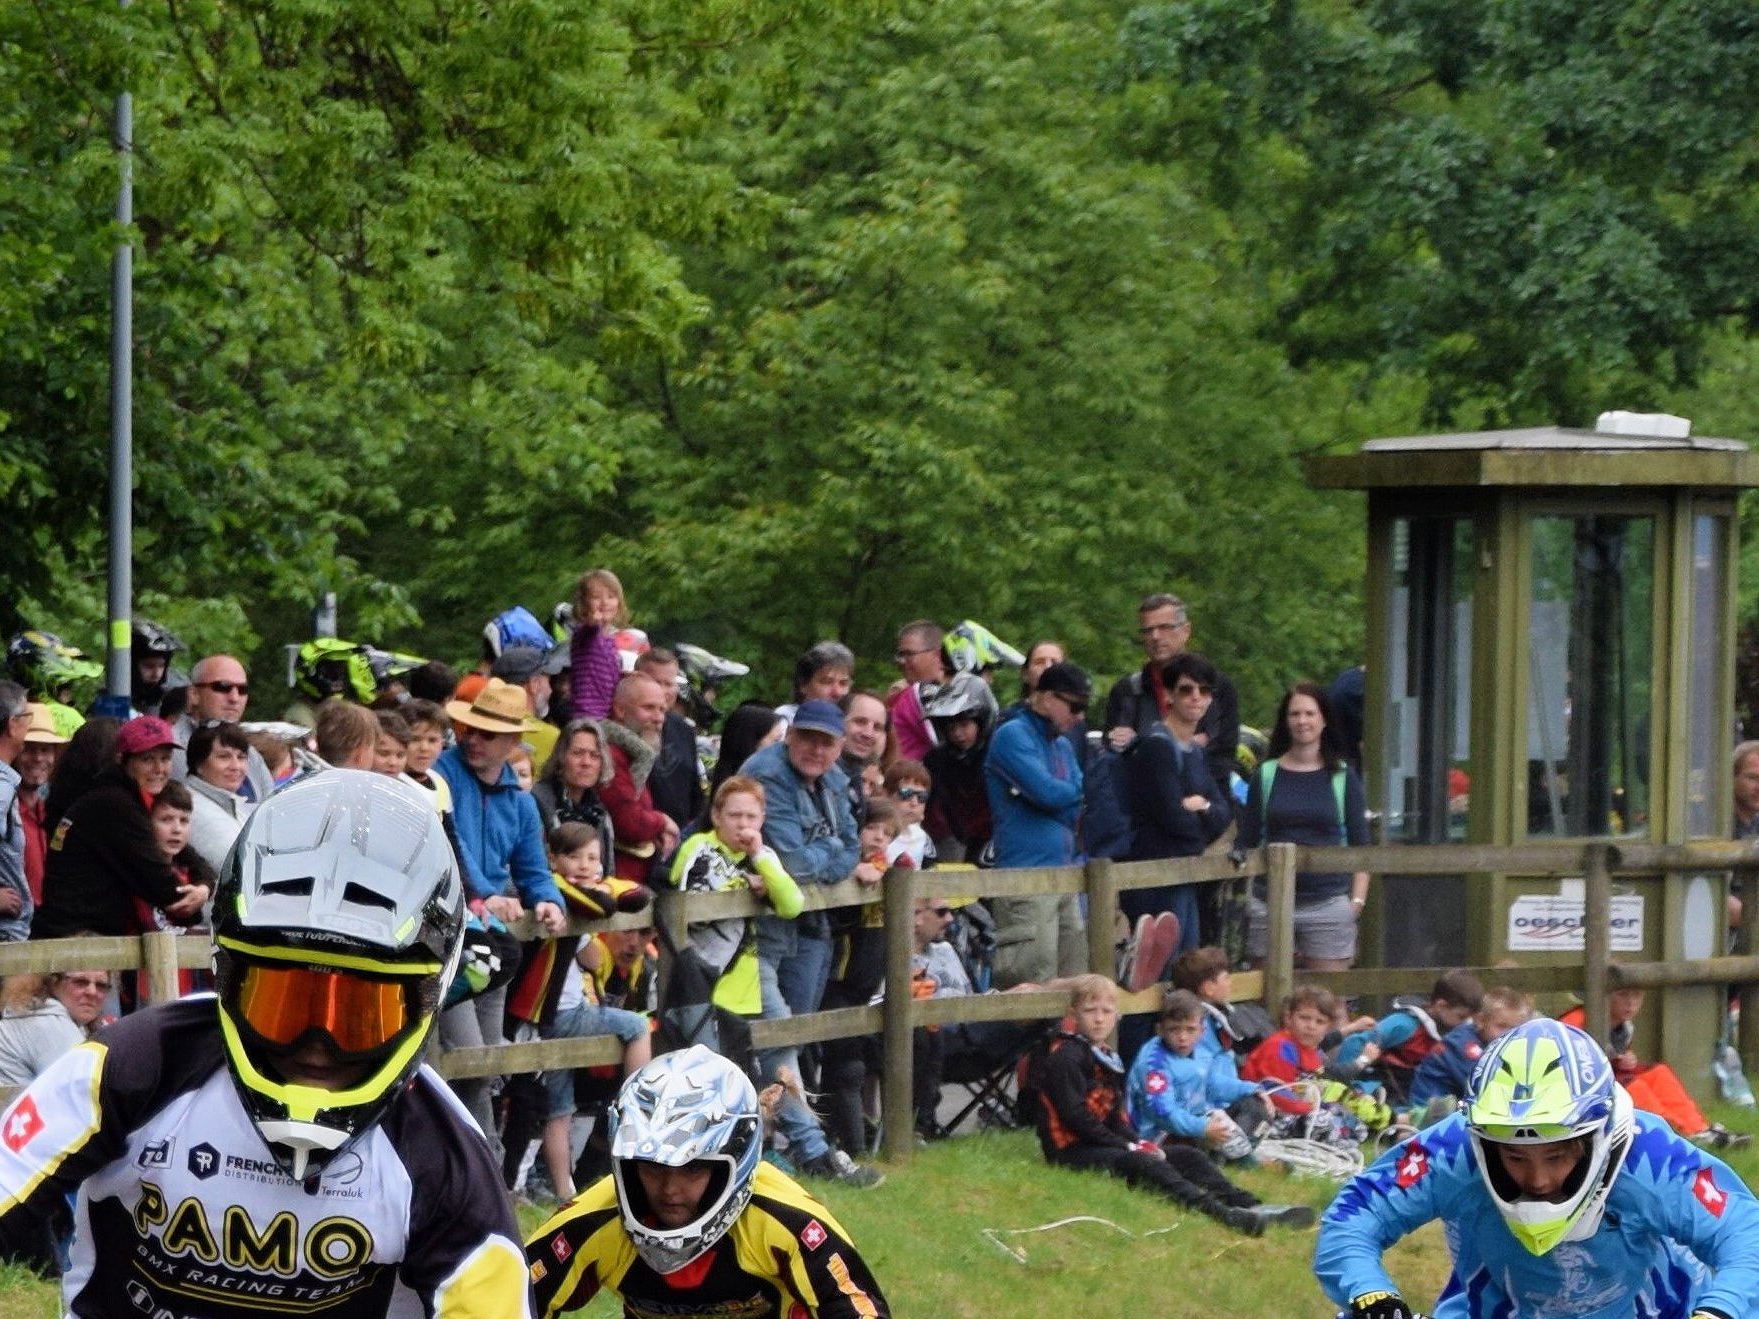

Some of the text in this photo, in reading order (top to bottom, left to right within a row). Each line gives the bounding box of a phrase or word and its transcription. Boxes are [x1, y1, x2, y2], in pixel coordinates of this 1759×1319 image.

[133, 1180, 374, 1279] PAMO
[137, 1244, 177, 1275] BMX
[187, 1270, 286, 1296] RACING
